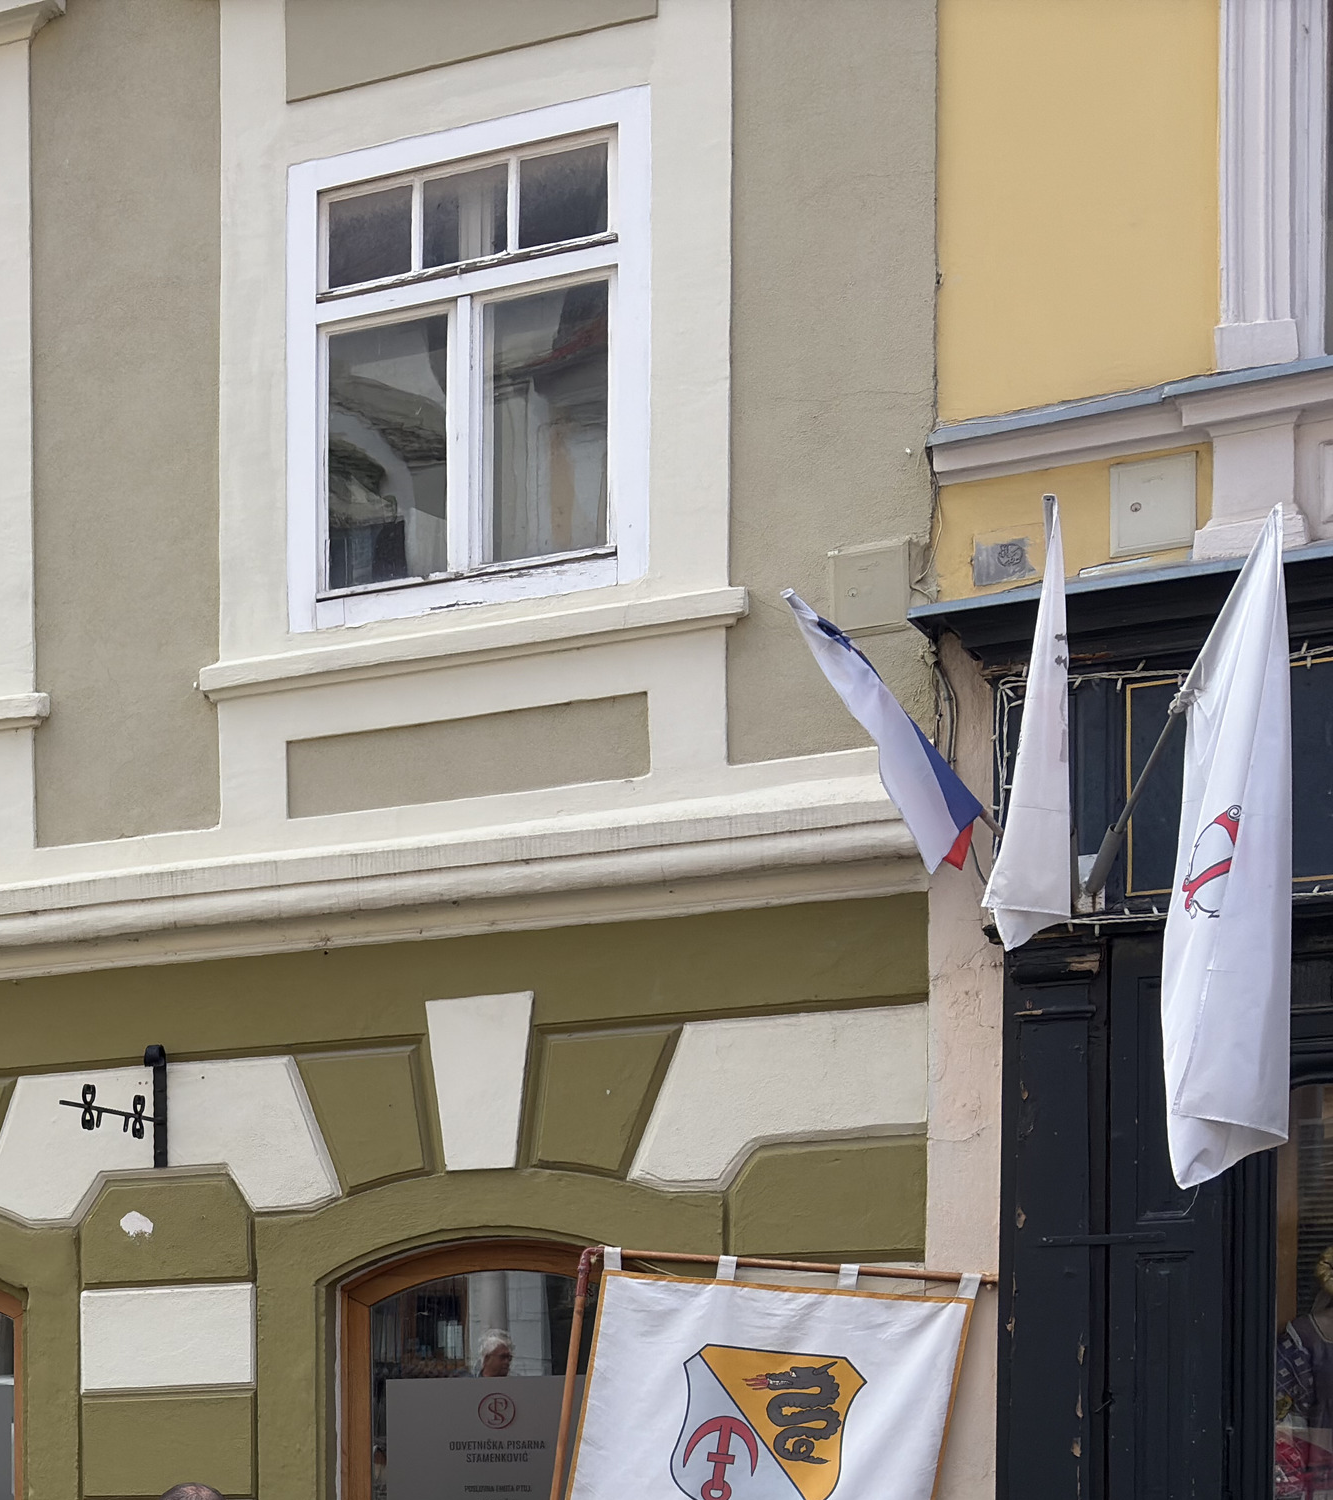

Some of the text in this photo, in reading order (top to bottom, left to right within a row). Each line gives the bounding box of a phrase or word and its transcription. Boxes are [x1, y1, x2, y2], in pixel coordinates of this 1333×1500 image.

[449, 1438, 546, 1450] ODVETNIŠKA PISARNA
[466, 1451, 528, 1463] STAMENKOVIĆ
